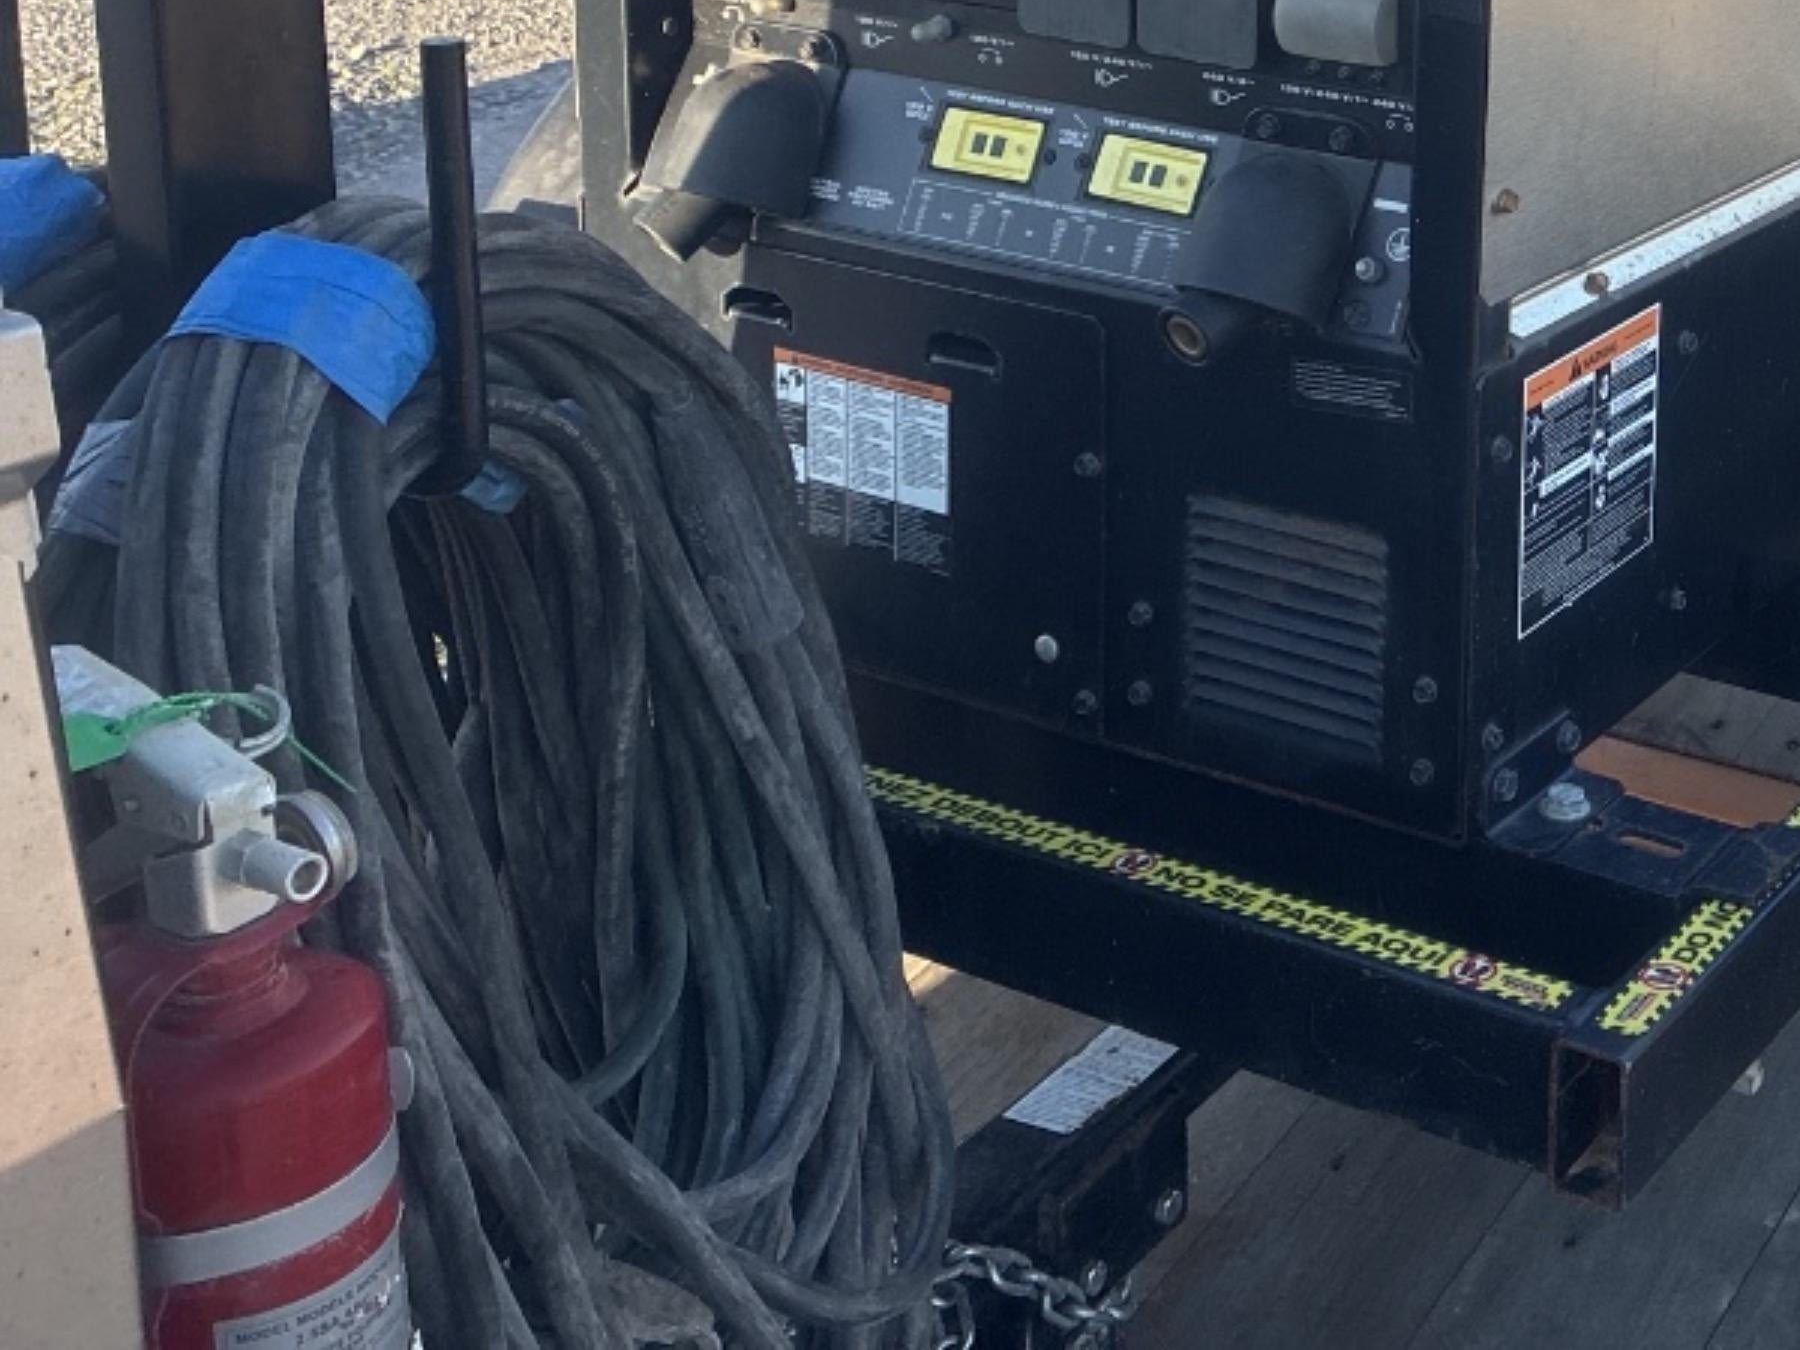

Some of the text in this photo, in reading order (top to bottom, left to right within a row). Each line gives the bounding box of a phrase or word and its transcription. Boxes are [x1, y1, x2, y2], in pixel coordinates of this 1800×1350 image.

[931, 796, 1066, 844] DEBOUT
[1153, 864, 1208, 889] NO
[1208, 882, 1259, 905] SE
[1260, 898, 1355, 938] PARE
[1358, 930, 1448, 968] AQUI
[1671, 932, 1714, 963] DO
